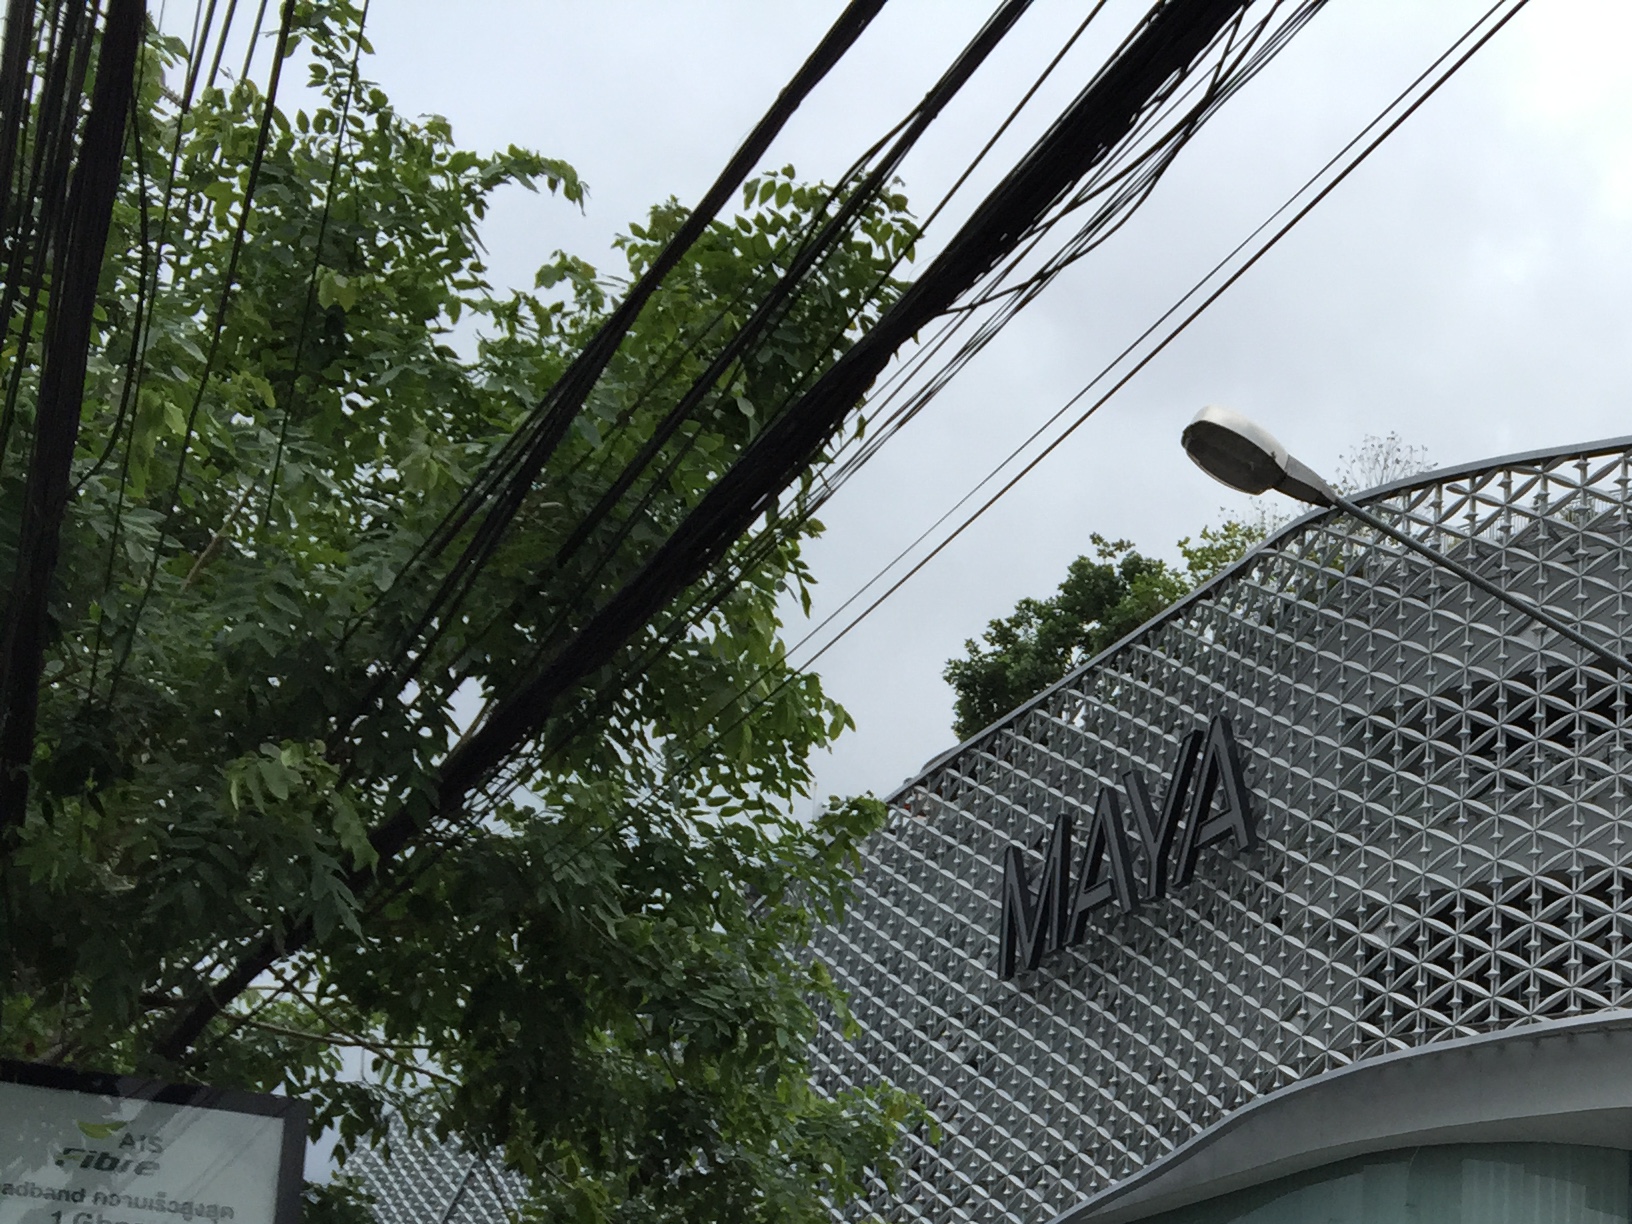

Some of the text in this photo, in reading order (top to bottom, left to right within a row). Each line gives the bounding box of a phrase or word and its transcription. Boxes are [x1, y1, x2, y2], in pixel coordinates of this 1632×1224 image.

[998, 714, 1258, 980] MAYA
[118, 1132, 164, 1154] AIS
[54, 1147, 161, 1177] Fibre
